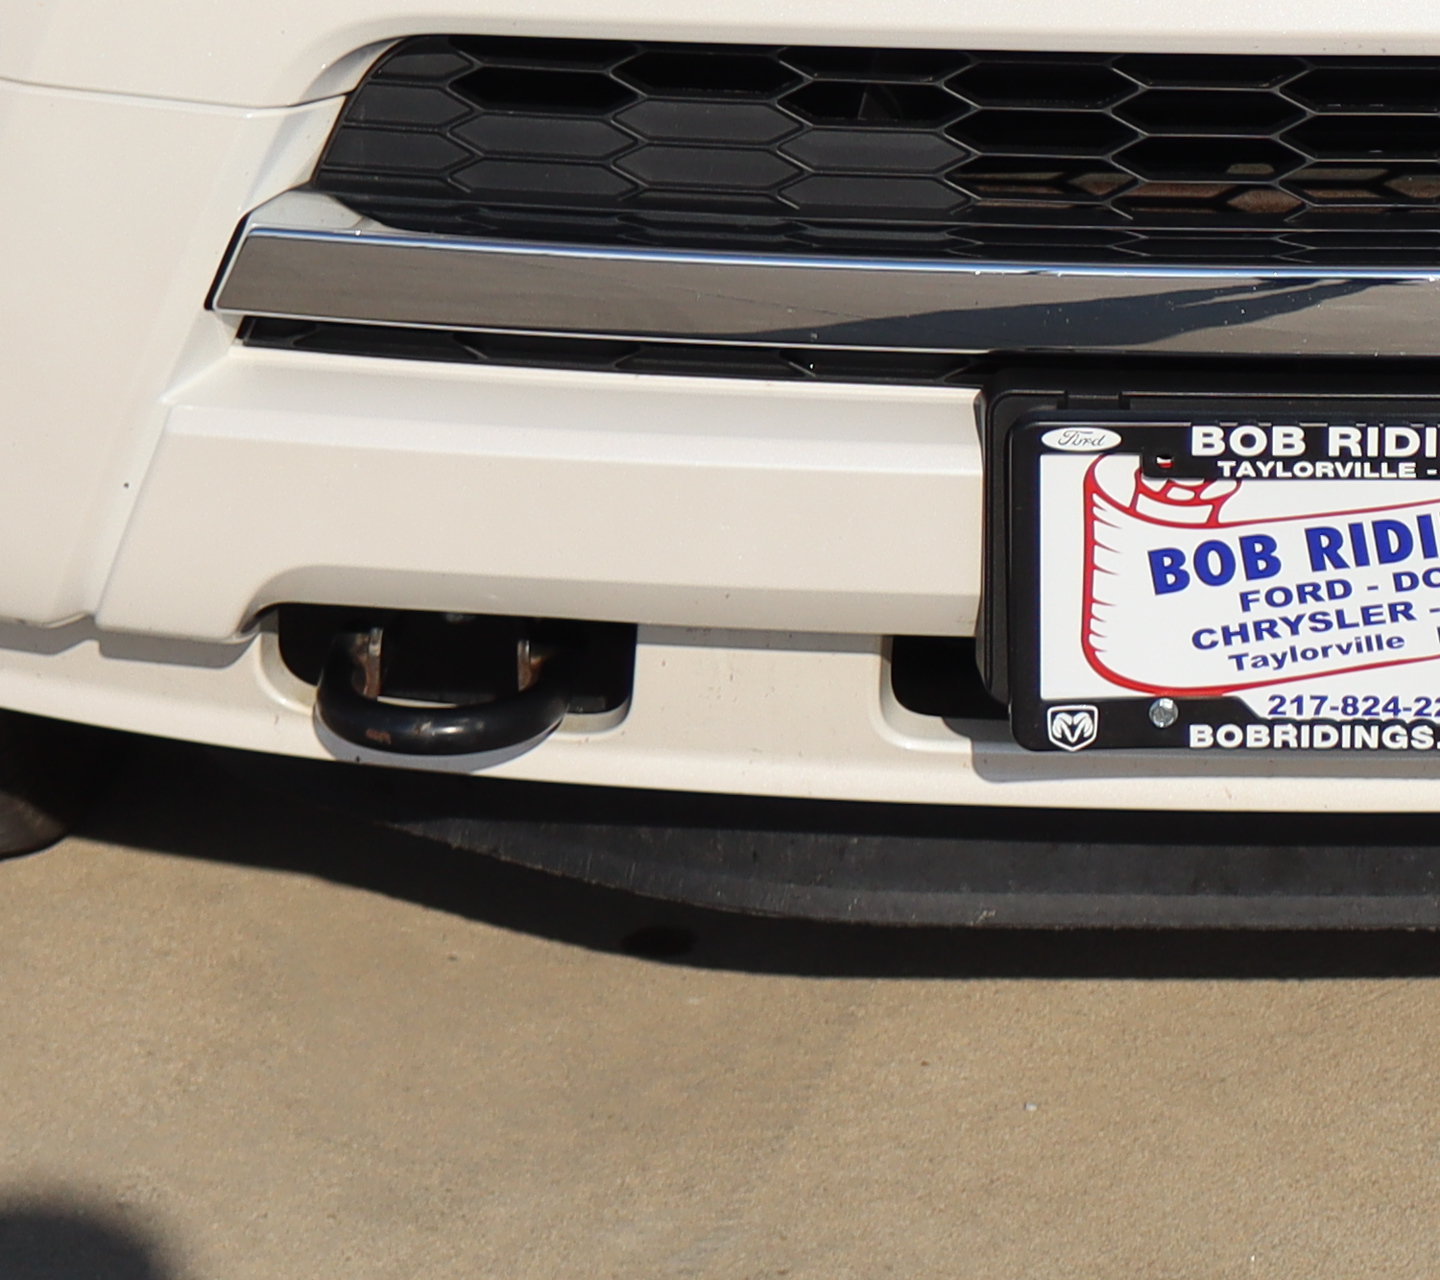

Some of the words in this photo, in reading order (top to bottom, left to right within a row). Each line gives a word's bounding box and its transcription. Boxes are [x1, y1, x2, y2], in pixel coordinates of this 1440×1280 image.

[1058, 430, 1106, 446] Ford
[1192, 427, 1306, 458] BOB
[1217, 461, 1417, 480] TAYLORVILLE
[1147, 534, 1282, 596] BOB
[1239, 578, 1353, 613] FORD
[1191, 600, 1417, 651] CHRYSLER
[1228, 634, 1406, 672] Taylorville
